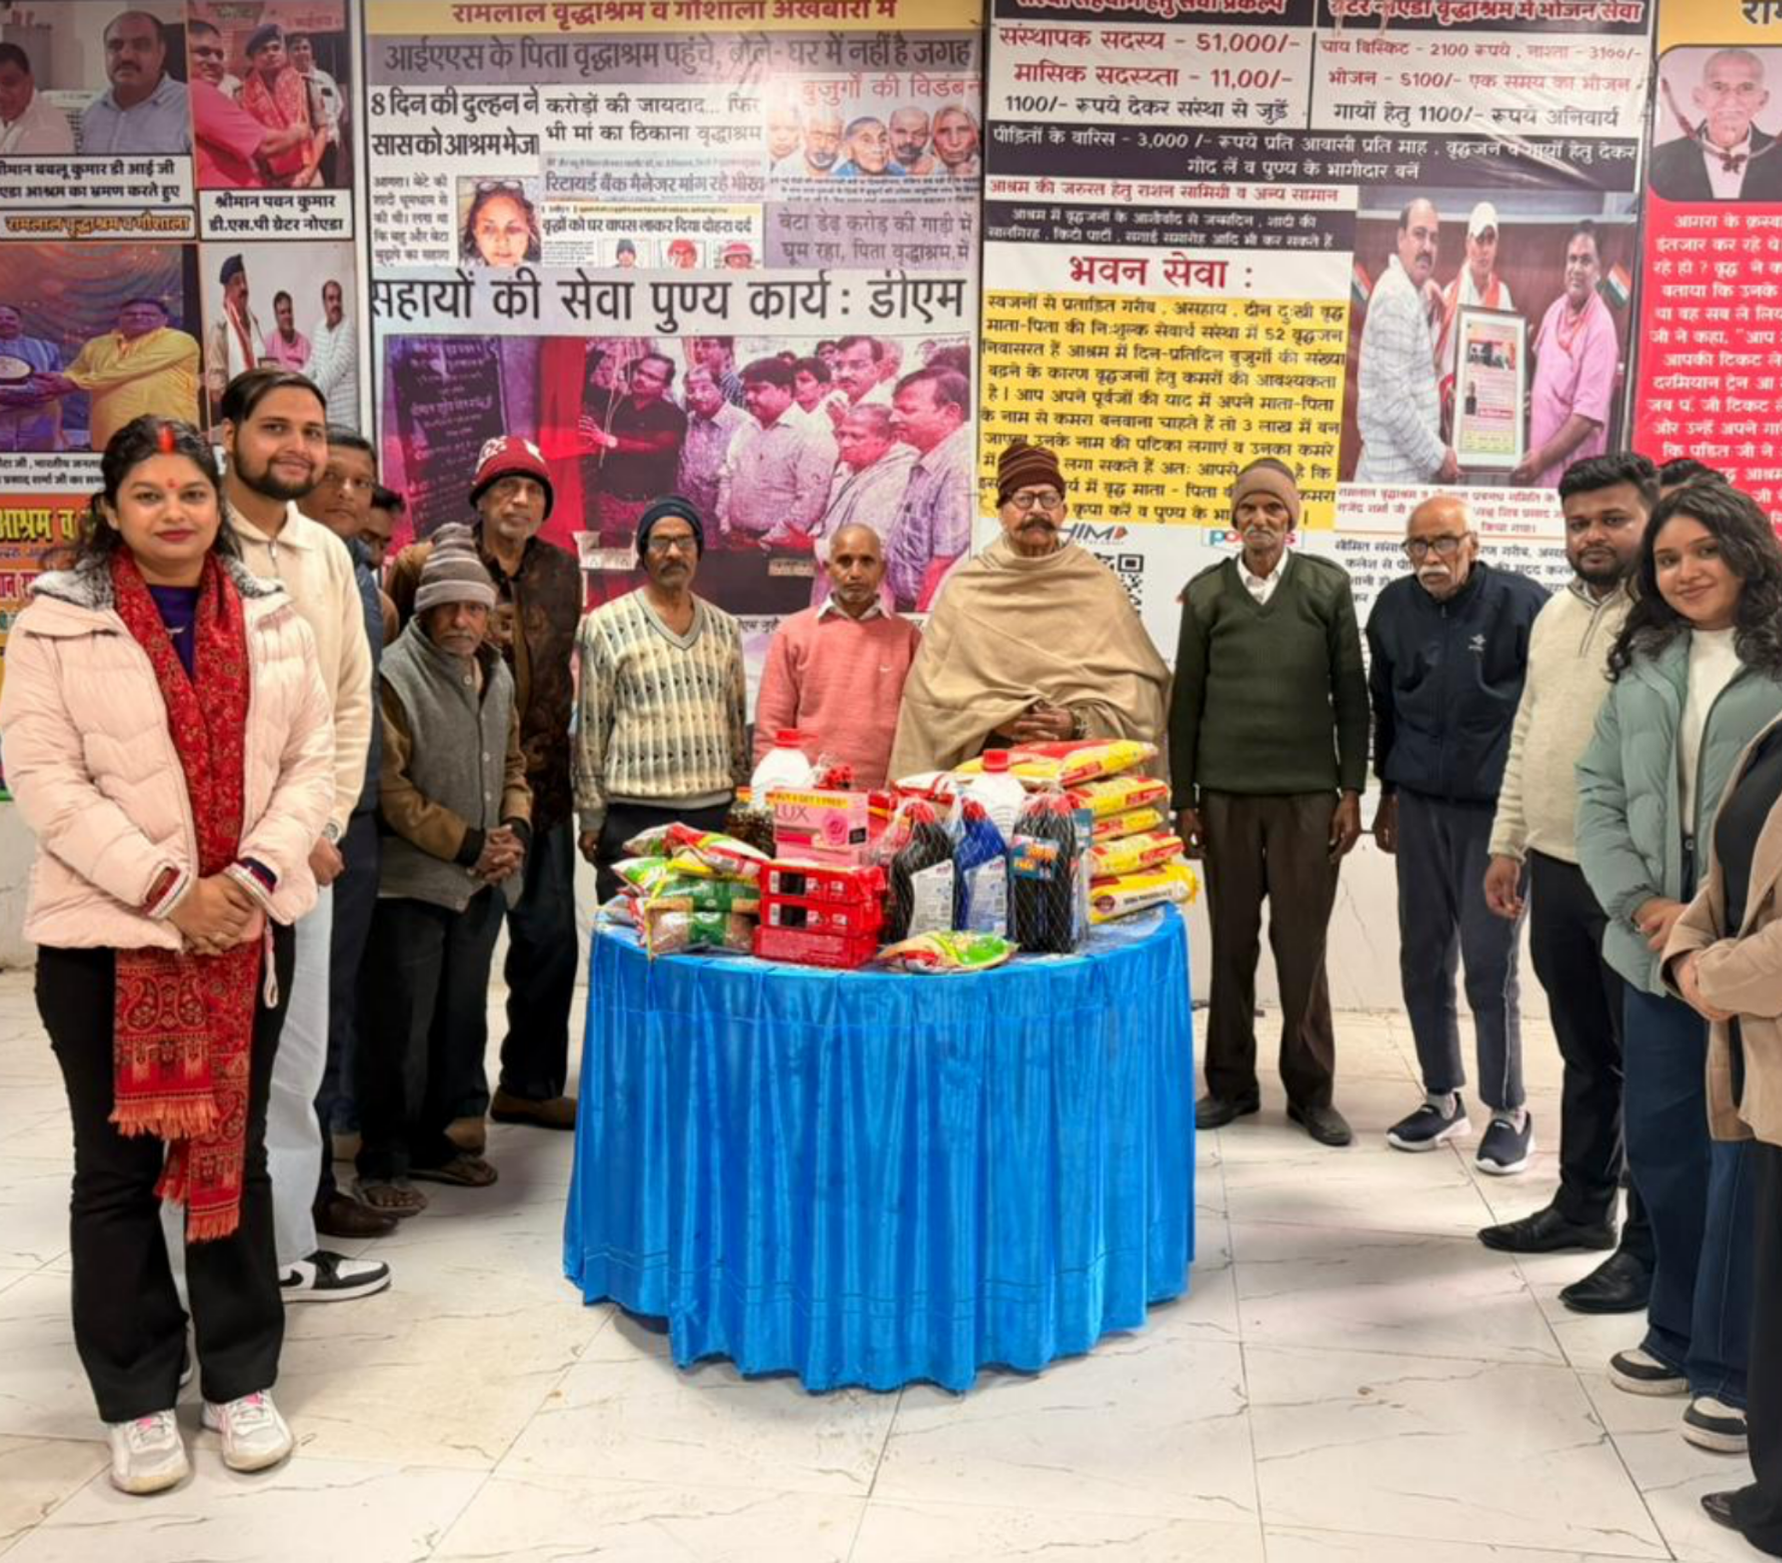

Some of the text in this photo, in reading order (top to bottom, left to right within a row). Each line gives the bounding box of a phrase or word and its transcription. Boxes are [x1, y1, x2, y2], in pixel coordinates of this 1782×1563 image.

[999, 26, 1092, 48] संस्थापक
[1100, 30, 1165, 50] सदस्य
[1196, 32, 1300, 54] 51,000/-
[385, 35, 484, 73] आईएएस
[490, 35, 513, 70] के
[520, 38, 569, 68] पिता
[574, 39, 659, 76] वृद्धाश्रम
[788, 38, 820, 62] घर
[824, 32, 844, 66] में
[848, 32, 890, 66] नहीं
[895, 33, 909, 66] है
[912, 38, 971, 65] जगह
[1014, 59, 1086, 82] मासिक
[1210, 69, 1293, 89] 11,00/-
[371, 85, 540, 122] 8 दिन की दुल्हन ने
[605, 92, 630, 114] की
[1005, 95, 1068, 112] 1100/-
[1128, 96, 1170, 115] देकर
[1177, 96, 1224, 117] संस्था
[1231, 97, 1248, 117] से
[1334, 100, 1375, 121] गायों
[1383, 102, 1411, 127] हेतु
[1420, 105, 1484, 123] 1100/-
[1546, 102, 1619, 127] अनिवार्य
[371, 127, 540, 156] सास को आश्रम भेजा
[545, 120, 566, 141] भी
[573, 122, 593, 141] मां
[599, 124, 624, 141] का
[630, 121, 689, 141] ठिकाना
[71, 163, 107, 181] कुमार
[128, 158, 156, 176] आई
[157, 158, 176, 176] जी
[26, 185, 66, 199] आश्रम
[68, 185, 87, 198] का
[129, 182, 161, 199] करते
[162, 182, 181, 203] हुए
[215, 193, 260, 209] श्रीमान
[297, 196, 336, 213] कुमार
[273, 217, 301, 232] ग्रेटर
[304, 217, 343, 231] नोएडा
[778, 210, 809, 232] बेटा
[894, 213, 917, 232] की
[960, 212, 973, 232] में
[853, 239, 886, 260] पिता
[955, 239, 969, 260] में
[1069, 256, 1149, 286] भवन
[1163, 251, 1229, 288] सेवा
[557, 267, 635, 320] सेवा
[650, 282, 732, 334] पुण्य
[747, 270, 832, 319] कार्य
[1043, 296, 1057, 311] से
[1174, 301, 1227, 315] असहाय
[987, 317, 1059, 333] माता-पिता
[1065, 318, 1085, 334] की
[1245, 325, 1257, 340] में
[1265, 330, 1285, 341] 52
